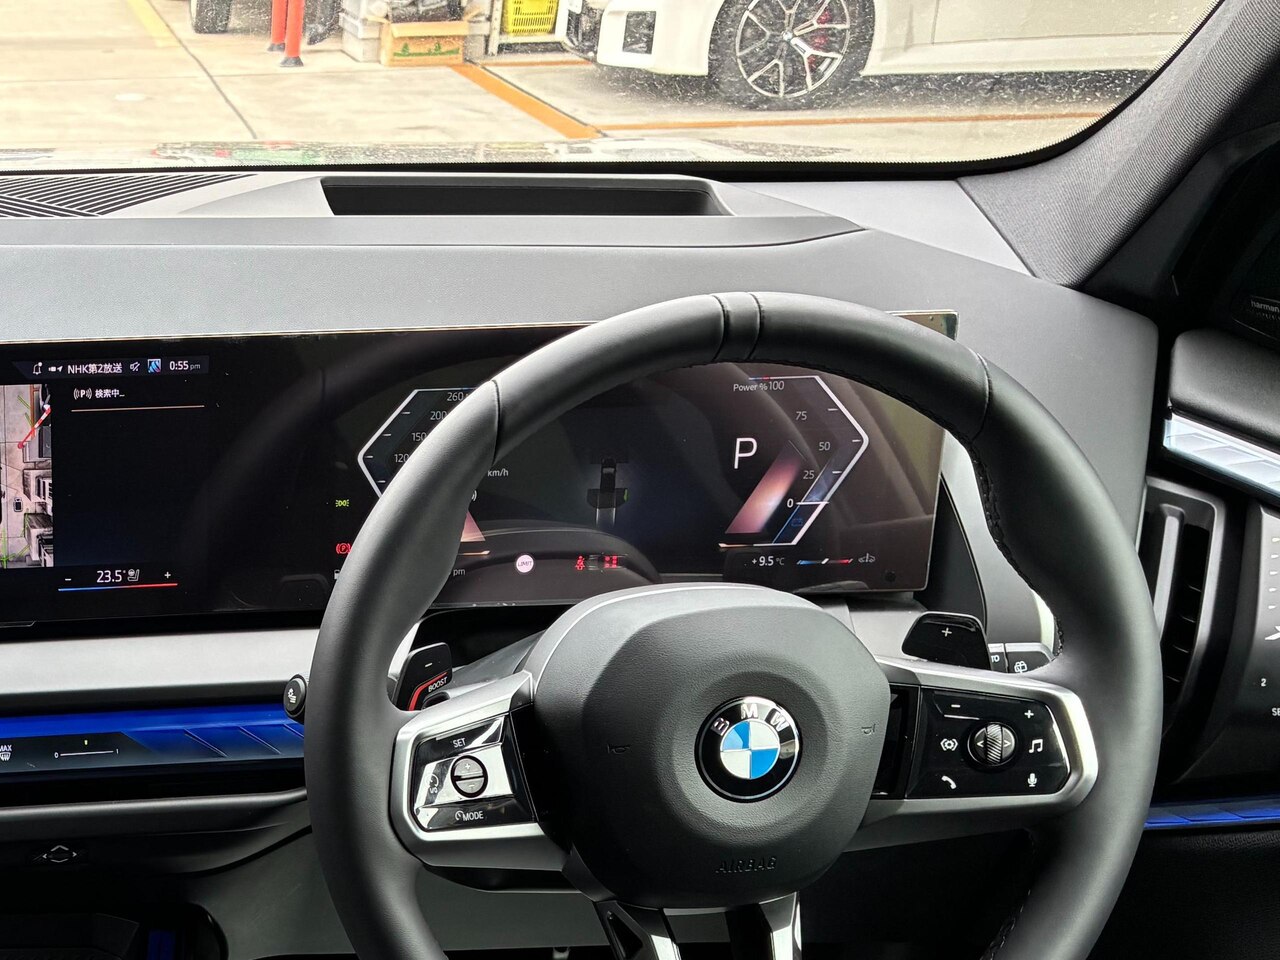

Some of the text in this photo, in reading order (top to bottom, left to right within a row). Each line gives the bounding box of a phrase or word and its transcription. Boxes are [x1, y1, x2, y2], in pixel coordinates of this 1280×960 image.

[67, 362, 123, 374] NHK第2放送
[169, 360, 201, 371] 0:55 pm
[733, 383, 758, 392] Power
[769, 380, 785, 391] 100
[446, 391, 464, 402] 260
[430, 410, 448, 421] 200
[795, 410, 808, 421] 75
[411, 432, 427, 442] 150
[818, 441, 831, 452] 50
[394, 453, 410, 464] 120
[733, 437, 758, 470] P
[487, 468, 509, 477] km/h
[802, 470, 815, 480] 25
[786, 498, 794, 508] 0
[452, 568, 466, 577] pm
[428, 677, 448, 693] BOOST
[1260, 678, 1267, 687] 2
[711, 703, 789, 737] BMW
[452, 737, 466, 748] SET
[462, 811, 484, 821] MODE
[715, 857, 776, 874] AIRBAG
